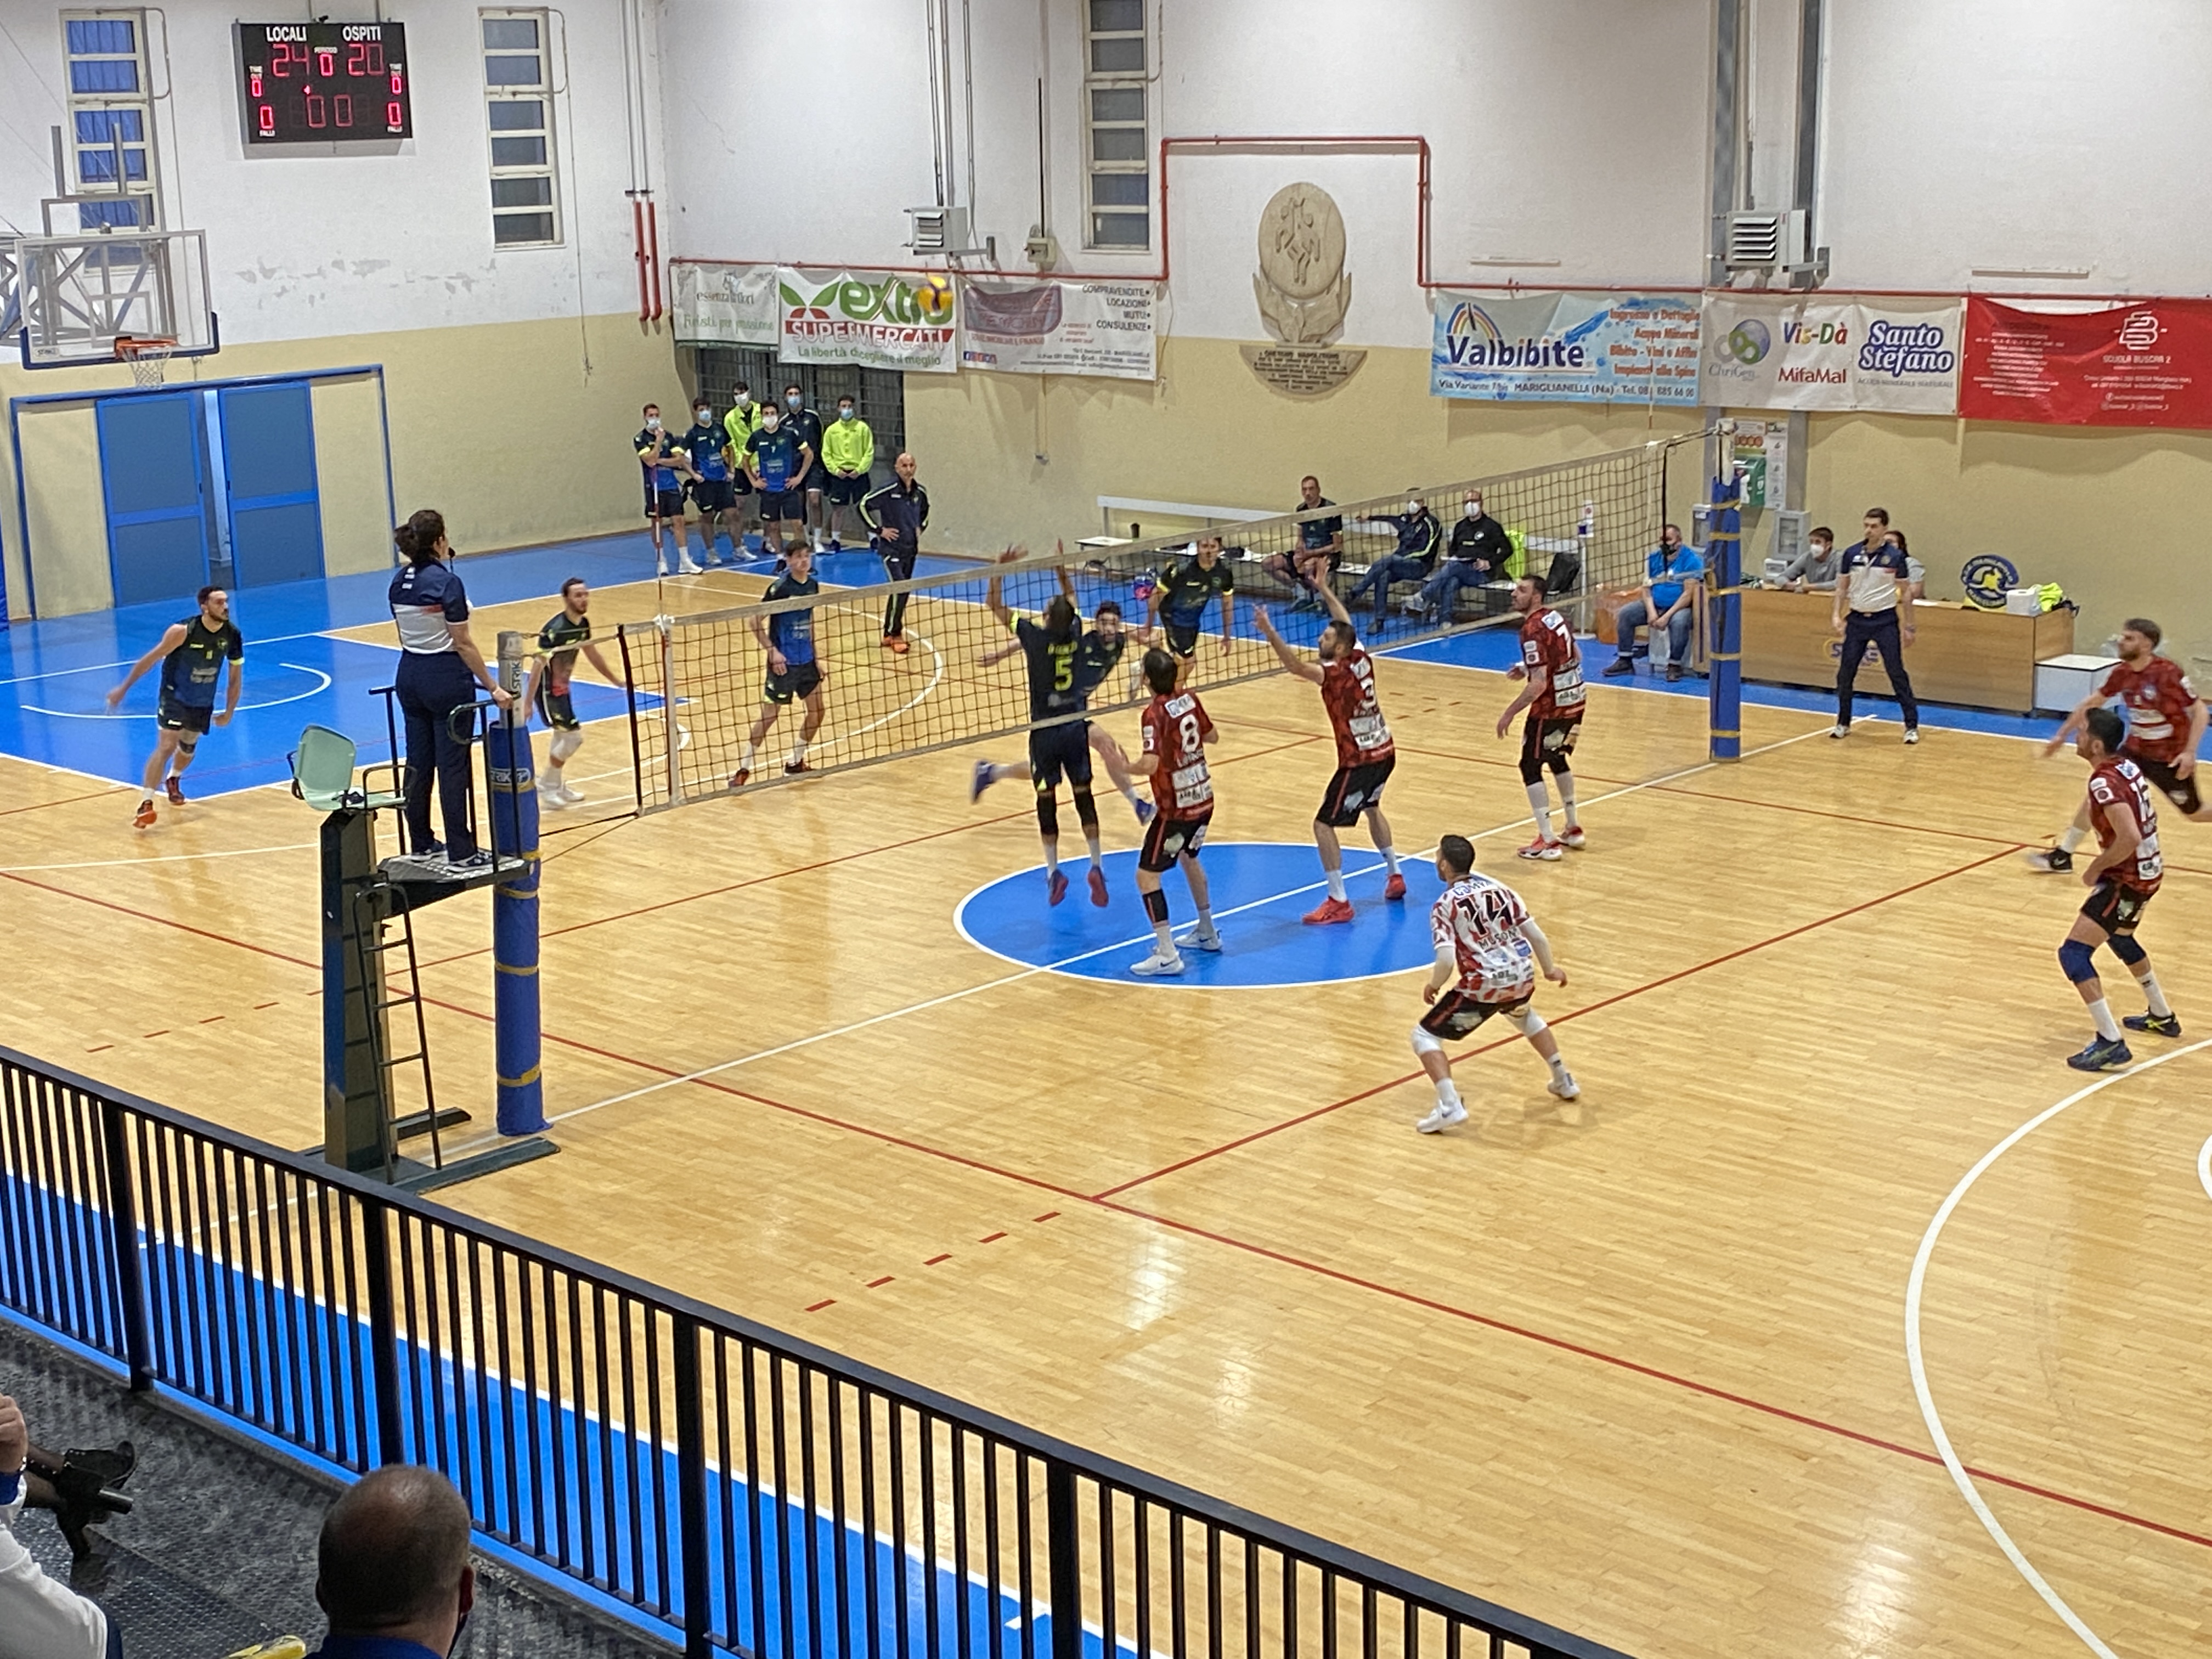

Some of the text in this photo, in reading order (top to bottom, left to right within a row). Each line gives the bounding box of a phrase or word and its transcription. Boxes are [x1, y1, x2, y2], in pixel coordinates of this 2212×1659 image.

[266, 26, 307, 42] LOCALI
[342, 26, 381, 42] OSPITI
[272, 43, 310, 77] 24
[347, 43, 385, 76] 20
[1082, 285, 1144, 297] COMPRAVENDITE
[792, 321, 944, 351] SUPERMERCATI
[1784, 321, 1848, 345] Vis-Dà
[1869, 320, 1943, 349] Santo
[798, 346, 810, 357] La
[811, 346, 847, 358] libertà
[905, 354, 941, 368] meglio
[1447, 335, 1584, 368] Valbibite
[1859, 344, 1954, 377] Stefano
[1514, 383, 1589, 393] MARIGLIANELLA
[1778, 367, 1847, 383] MifaMal
[1555, 624, 1572, 659] 7
[1054, 657, 1073, 691] 5
[1180, 714, 1200, 753] 8
[1456, 890, 1514, 935] 14
